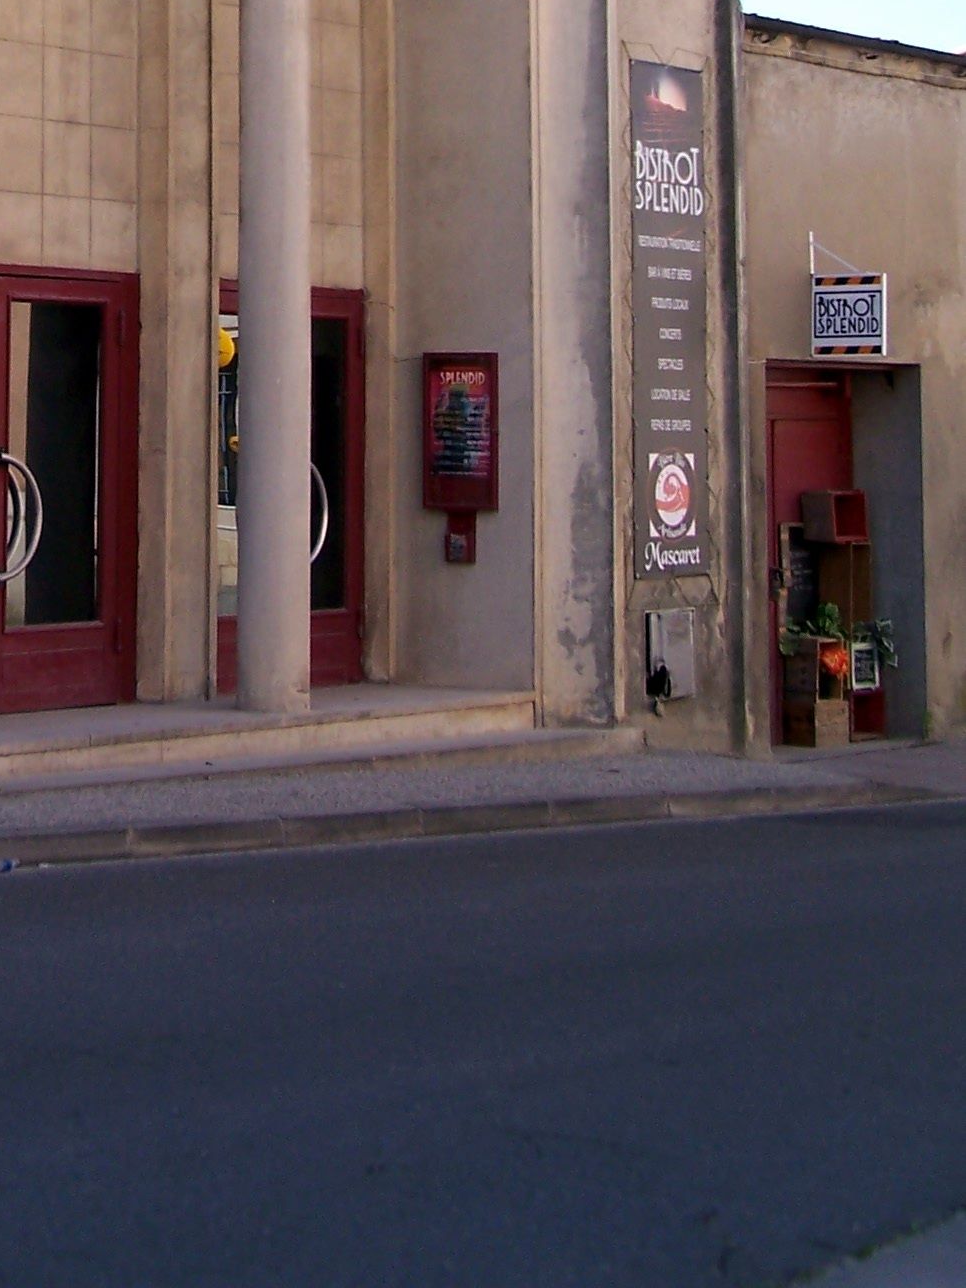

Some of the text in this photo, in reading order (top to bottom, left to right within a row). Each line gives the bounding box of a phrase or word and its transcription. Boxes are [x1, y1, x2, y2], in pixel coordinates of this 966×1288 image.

[635, 140, 700, 187] BISTROT
[635, 181, 704, 216] SPLENDID
[818, 295, 876, 318] BISTROT
[817, 317, 879, 334] SPLENDID
[440, 371, 486, 385] SPLENDID
[644, 542, 701, 571] Mascaret
